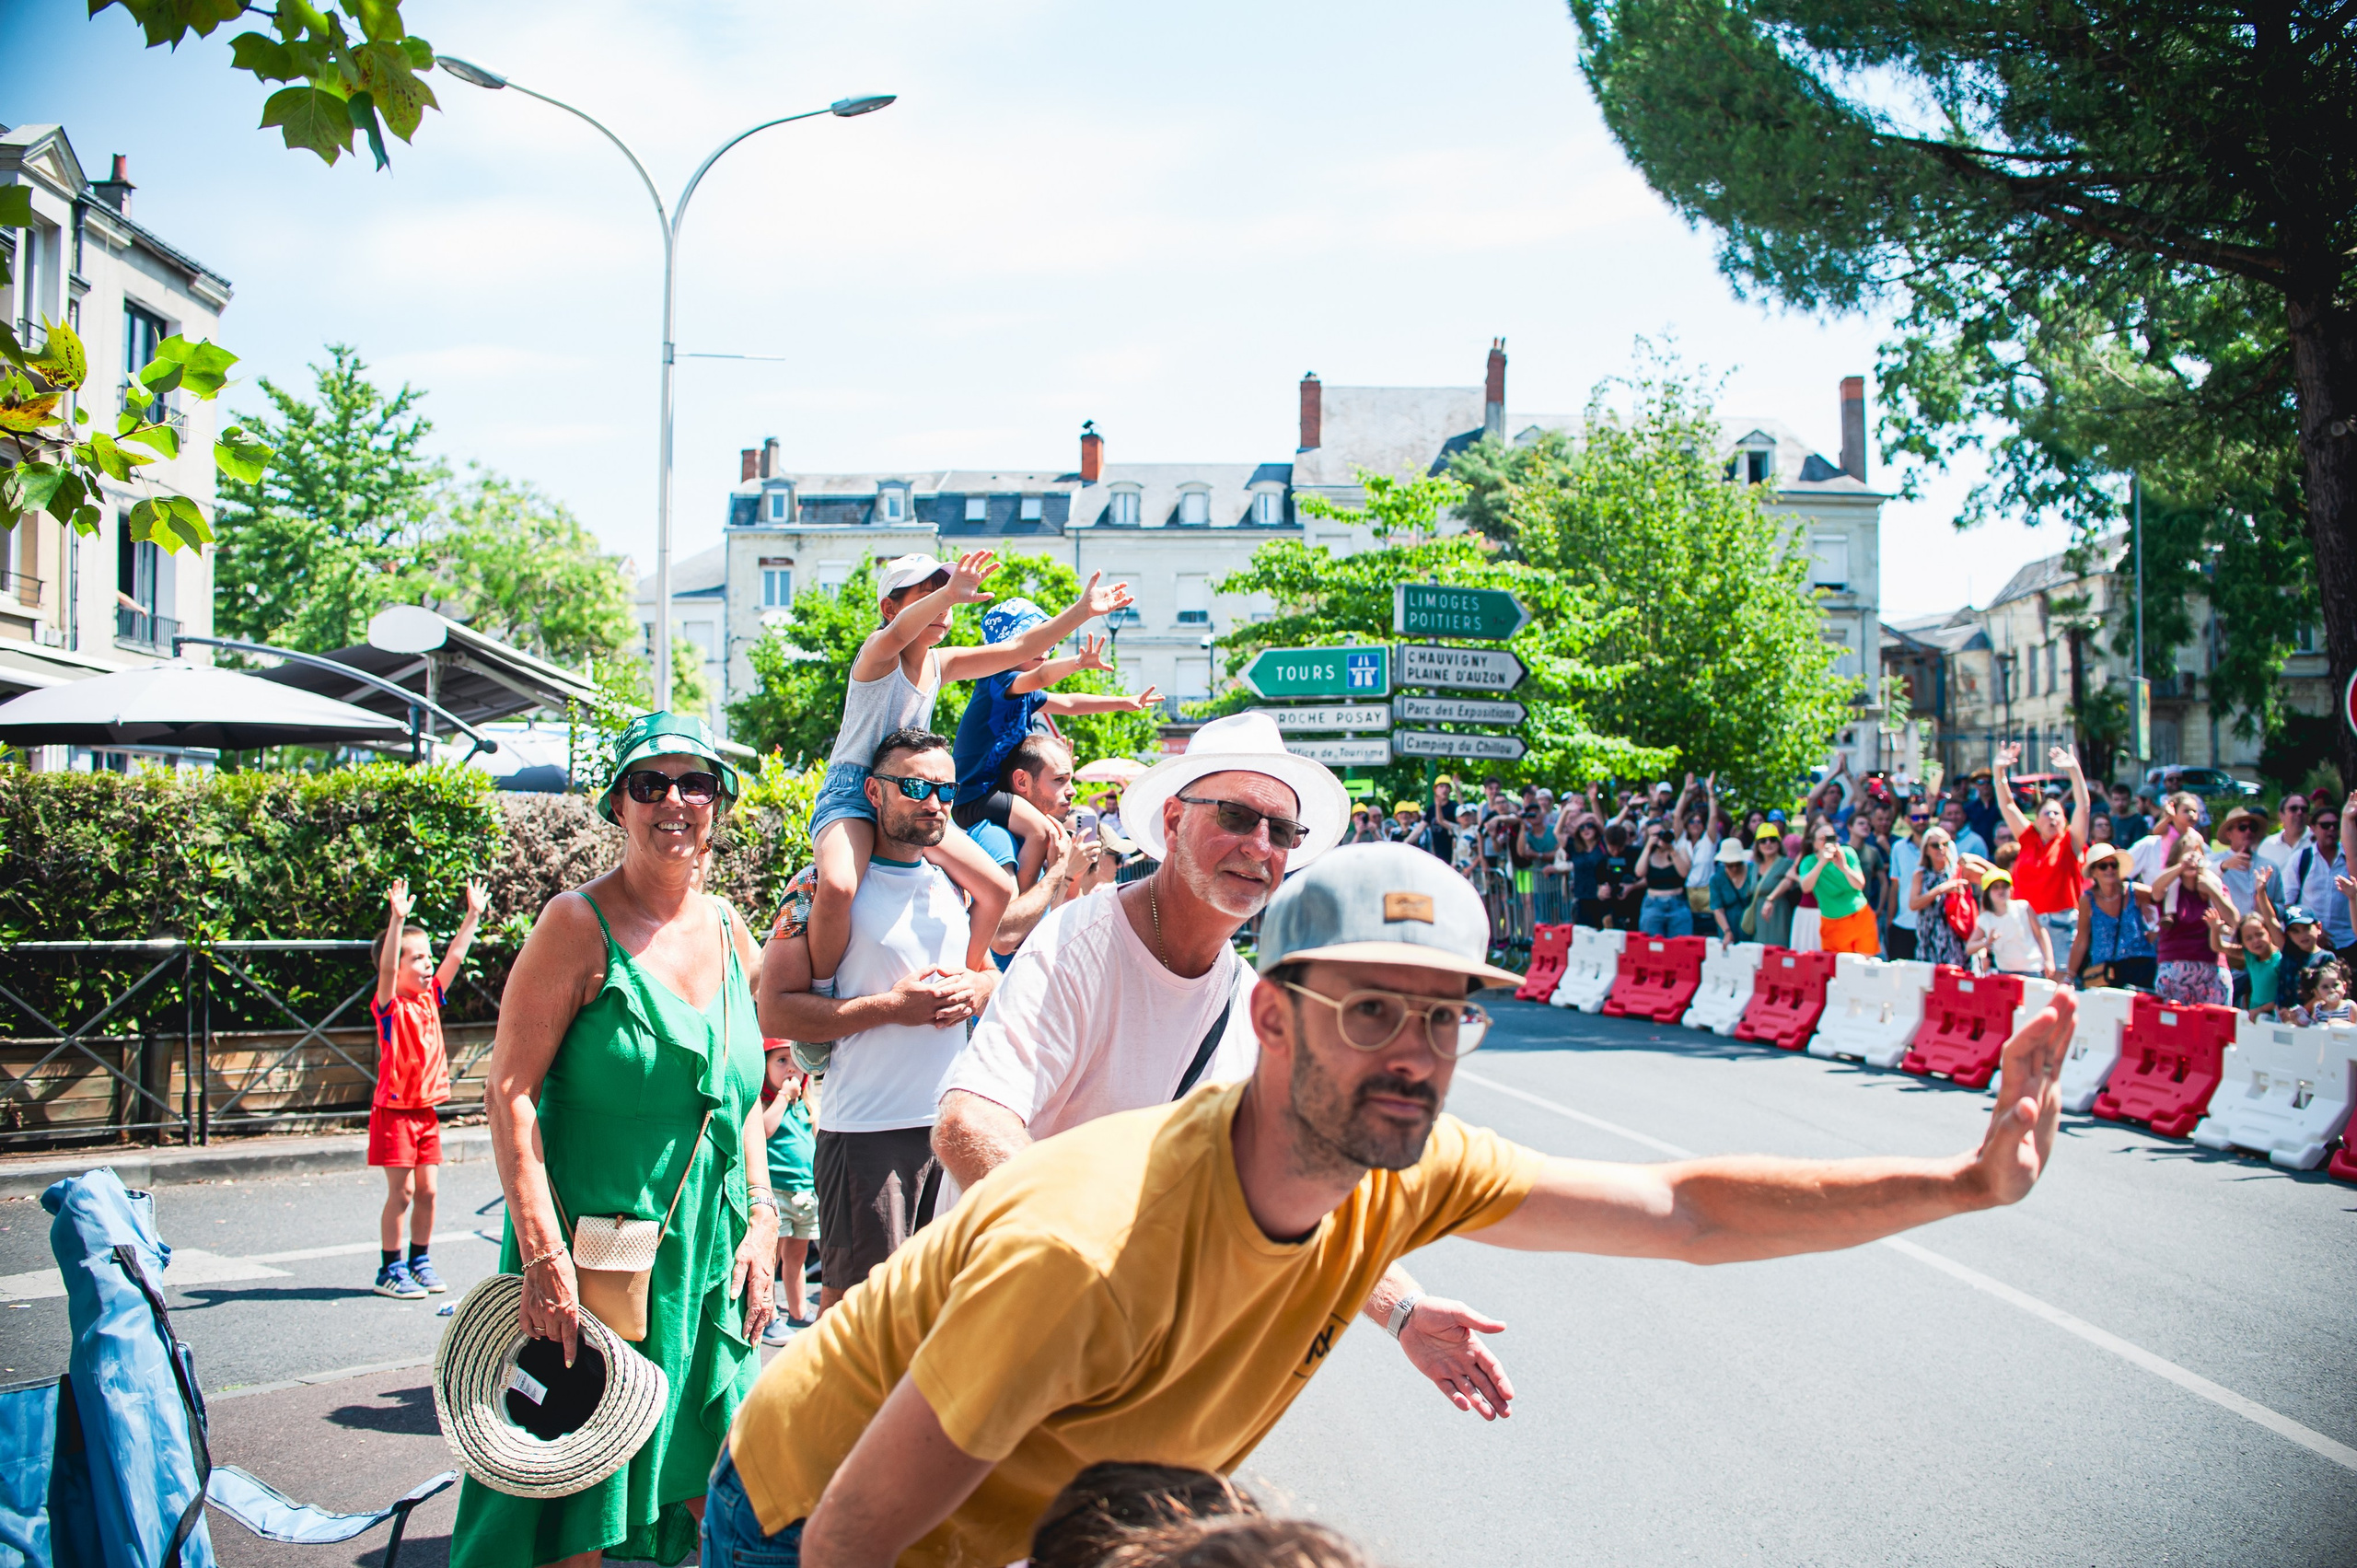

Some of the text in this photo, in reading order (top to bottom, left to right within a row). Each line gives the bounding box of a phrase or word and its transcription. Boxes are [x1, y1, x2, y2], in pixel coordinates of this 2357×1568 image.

[1409, 592, 1480, 611] LIMOGES
[984, 616, 1003, 626] Krys
[1409, 611, 1482, 631] POITIERS
[1408, 651, 1489, 668] CHAUVIGNY
[1275, 664, 1335, 681] TOURS
[1407, 667, 1506, 684] PLAINE D'AUZON
[1278, 712, 1383, 725] ROCHE POSAY
[1407, 702, 1516, 719] Parc des Expositions
[1321, 747, 1333, 757] de
[1340, 747, 1384, 758] Tourisme
[1406, 736, 1513, 754] Camping du Chillou
